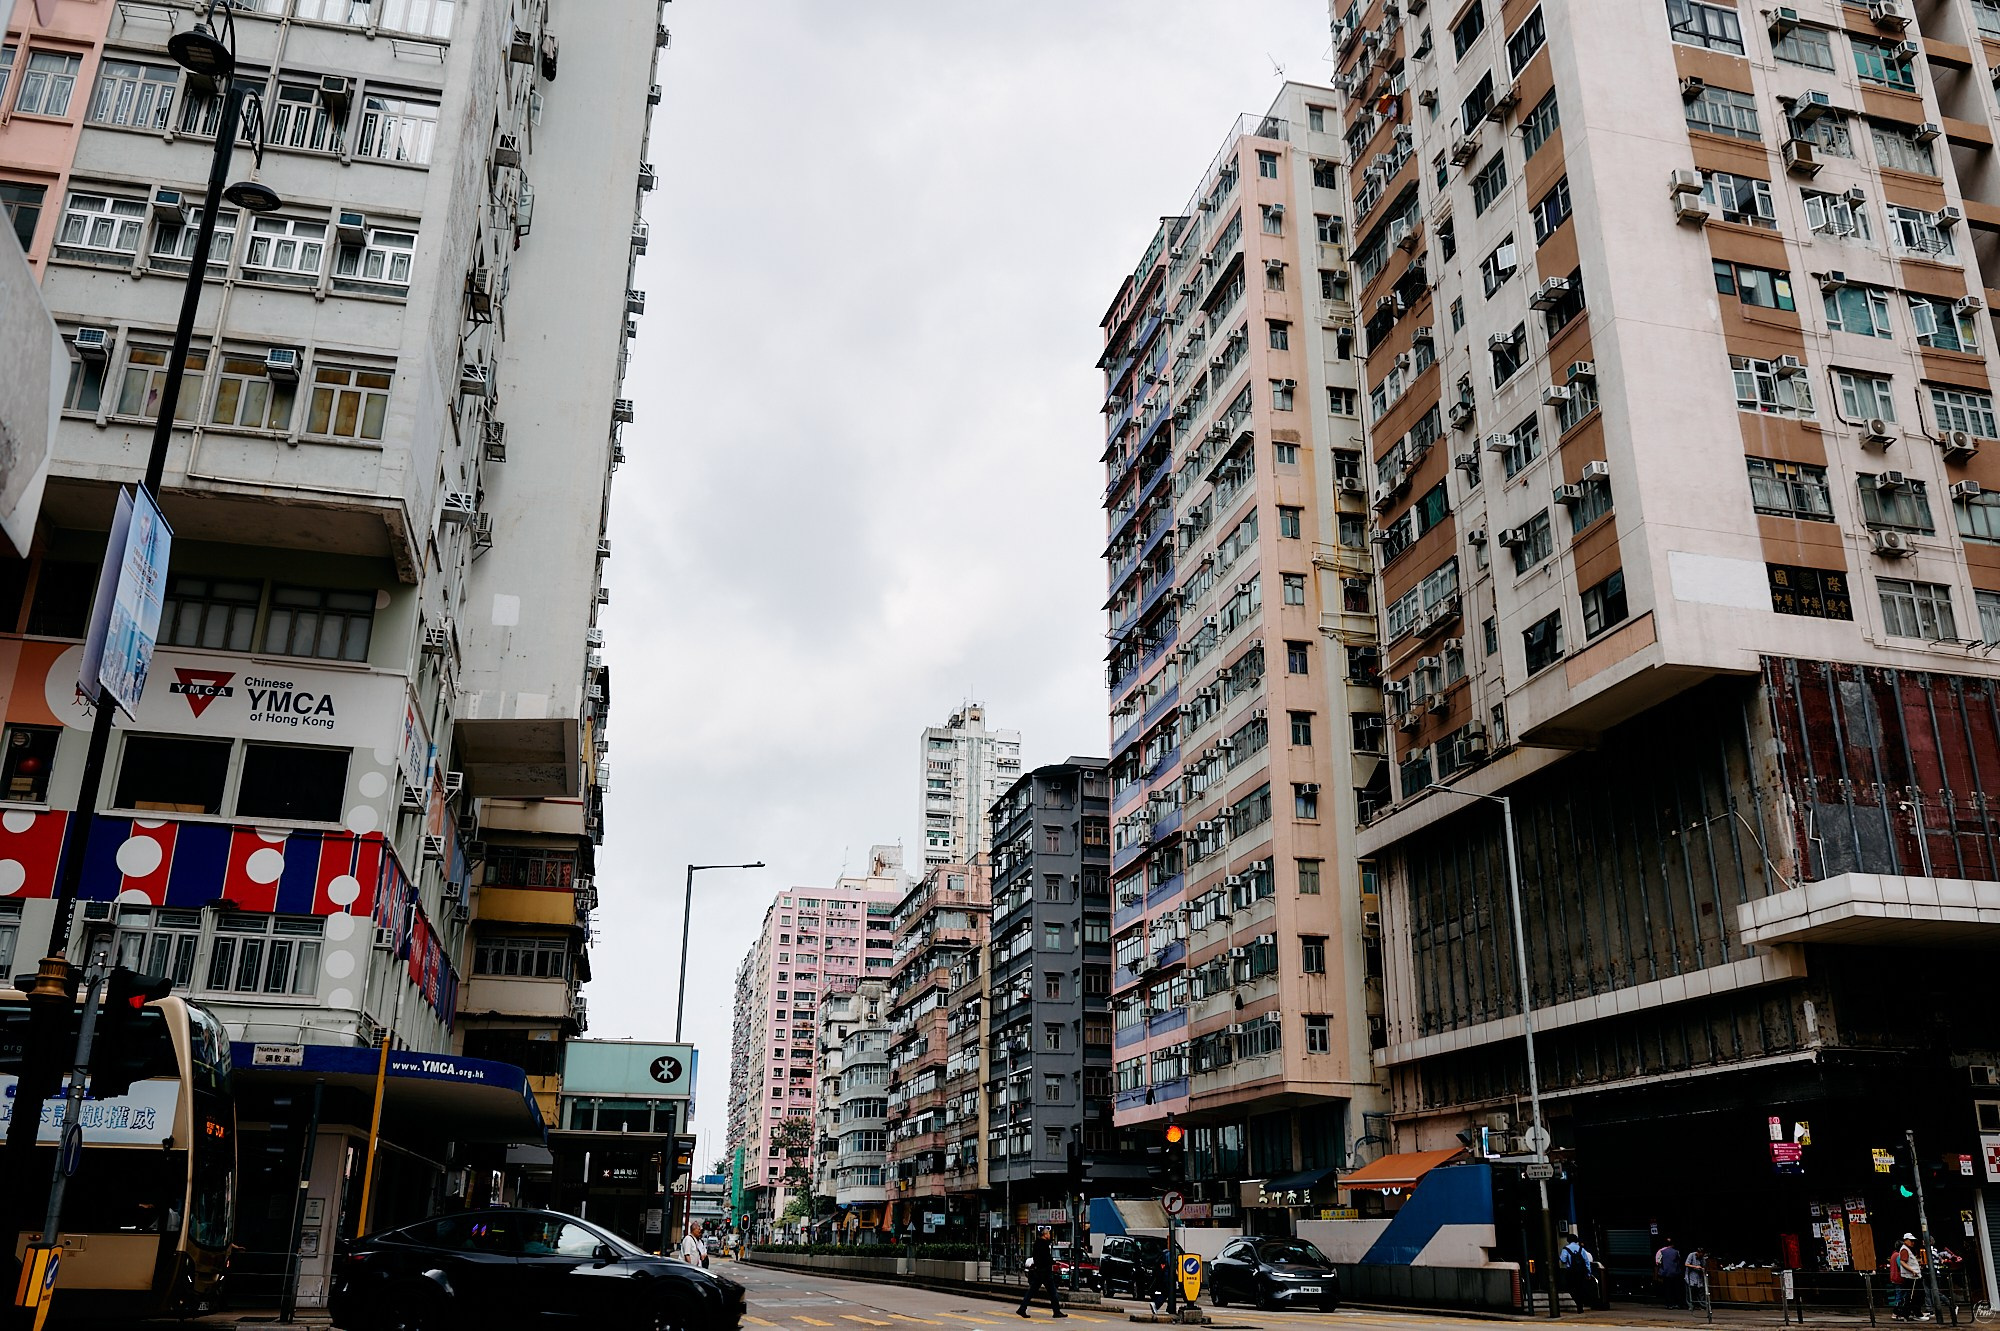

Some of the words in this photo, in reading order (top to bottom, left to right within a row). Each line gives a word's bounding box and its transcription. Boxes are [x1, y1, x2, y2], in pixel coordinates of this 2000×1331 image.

[176, 684, 227, 696] YMCA
[244, 677, 294, 690] Chinese
[247, 688, 335, 716] YMCA
[250, 712, 263, 722] of
[266, 713, 299, 727] Hong
[302, 716, 335, 730] Kong
[392, 1060, 484, 1078] www.YMCA.org.hk
